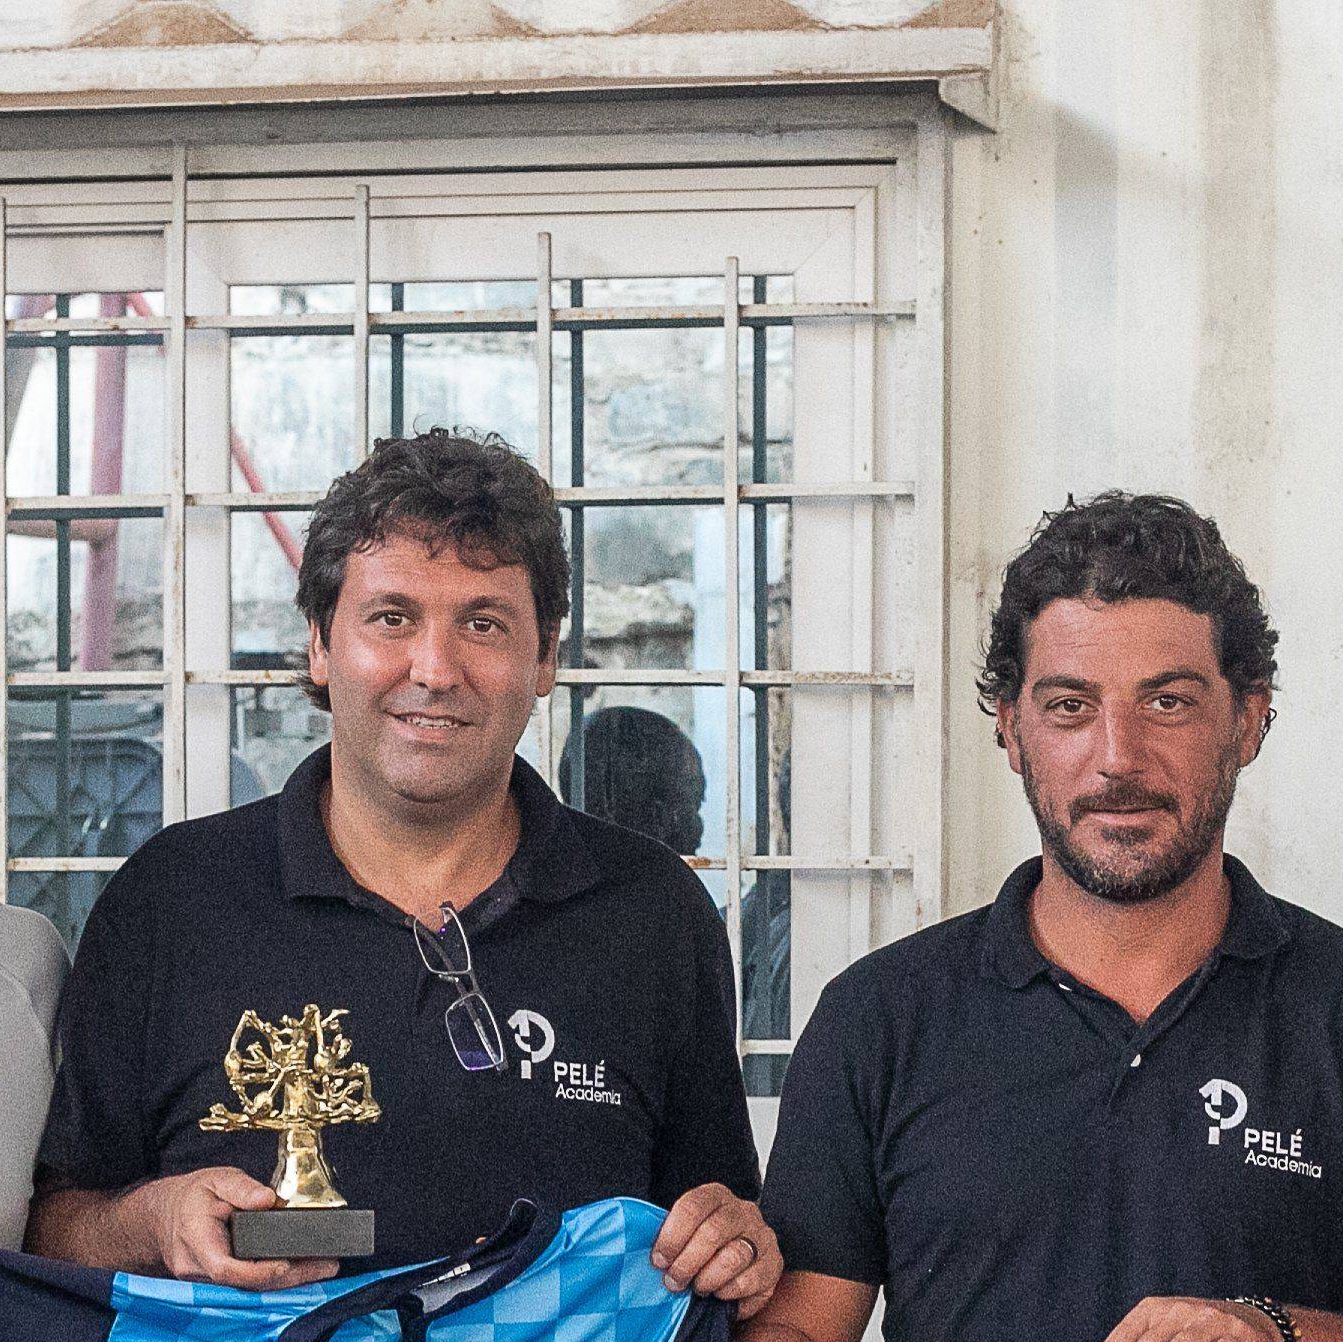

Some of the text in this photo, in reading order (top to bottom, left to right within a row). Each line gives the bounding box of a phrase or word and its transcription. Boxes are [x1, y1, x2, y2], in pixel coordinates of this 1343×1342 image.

[553, 1059, 605, 1088] PELÉ
[555, 1082, 621, 1106] Academia
[1243, 1127, 1303, 1157] PELÉ
[1244, 1149, 1322, 1178] Academia
